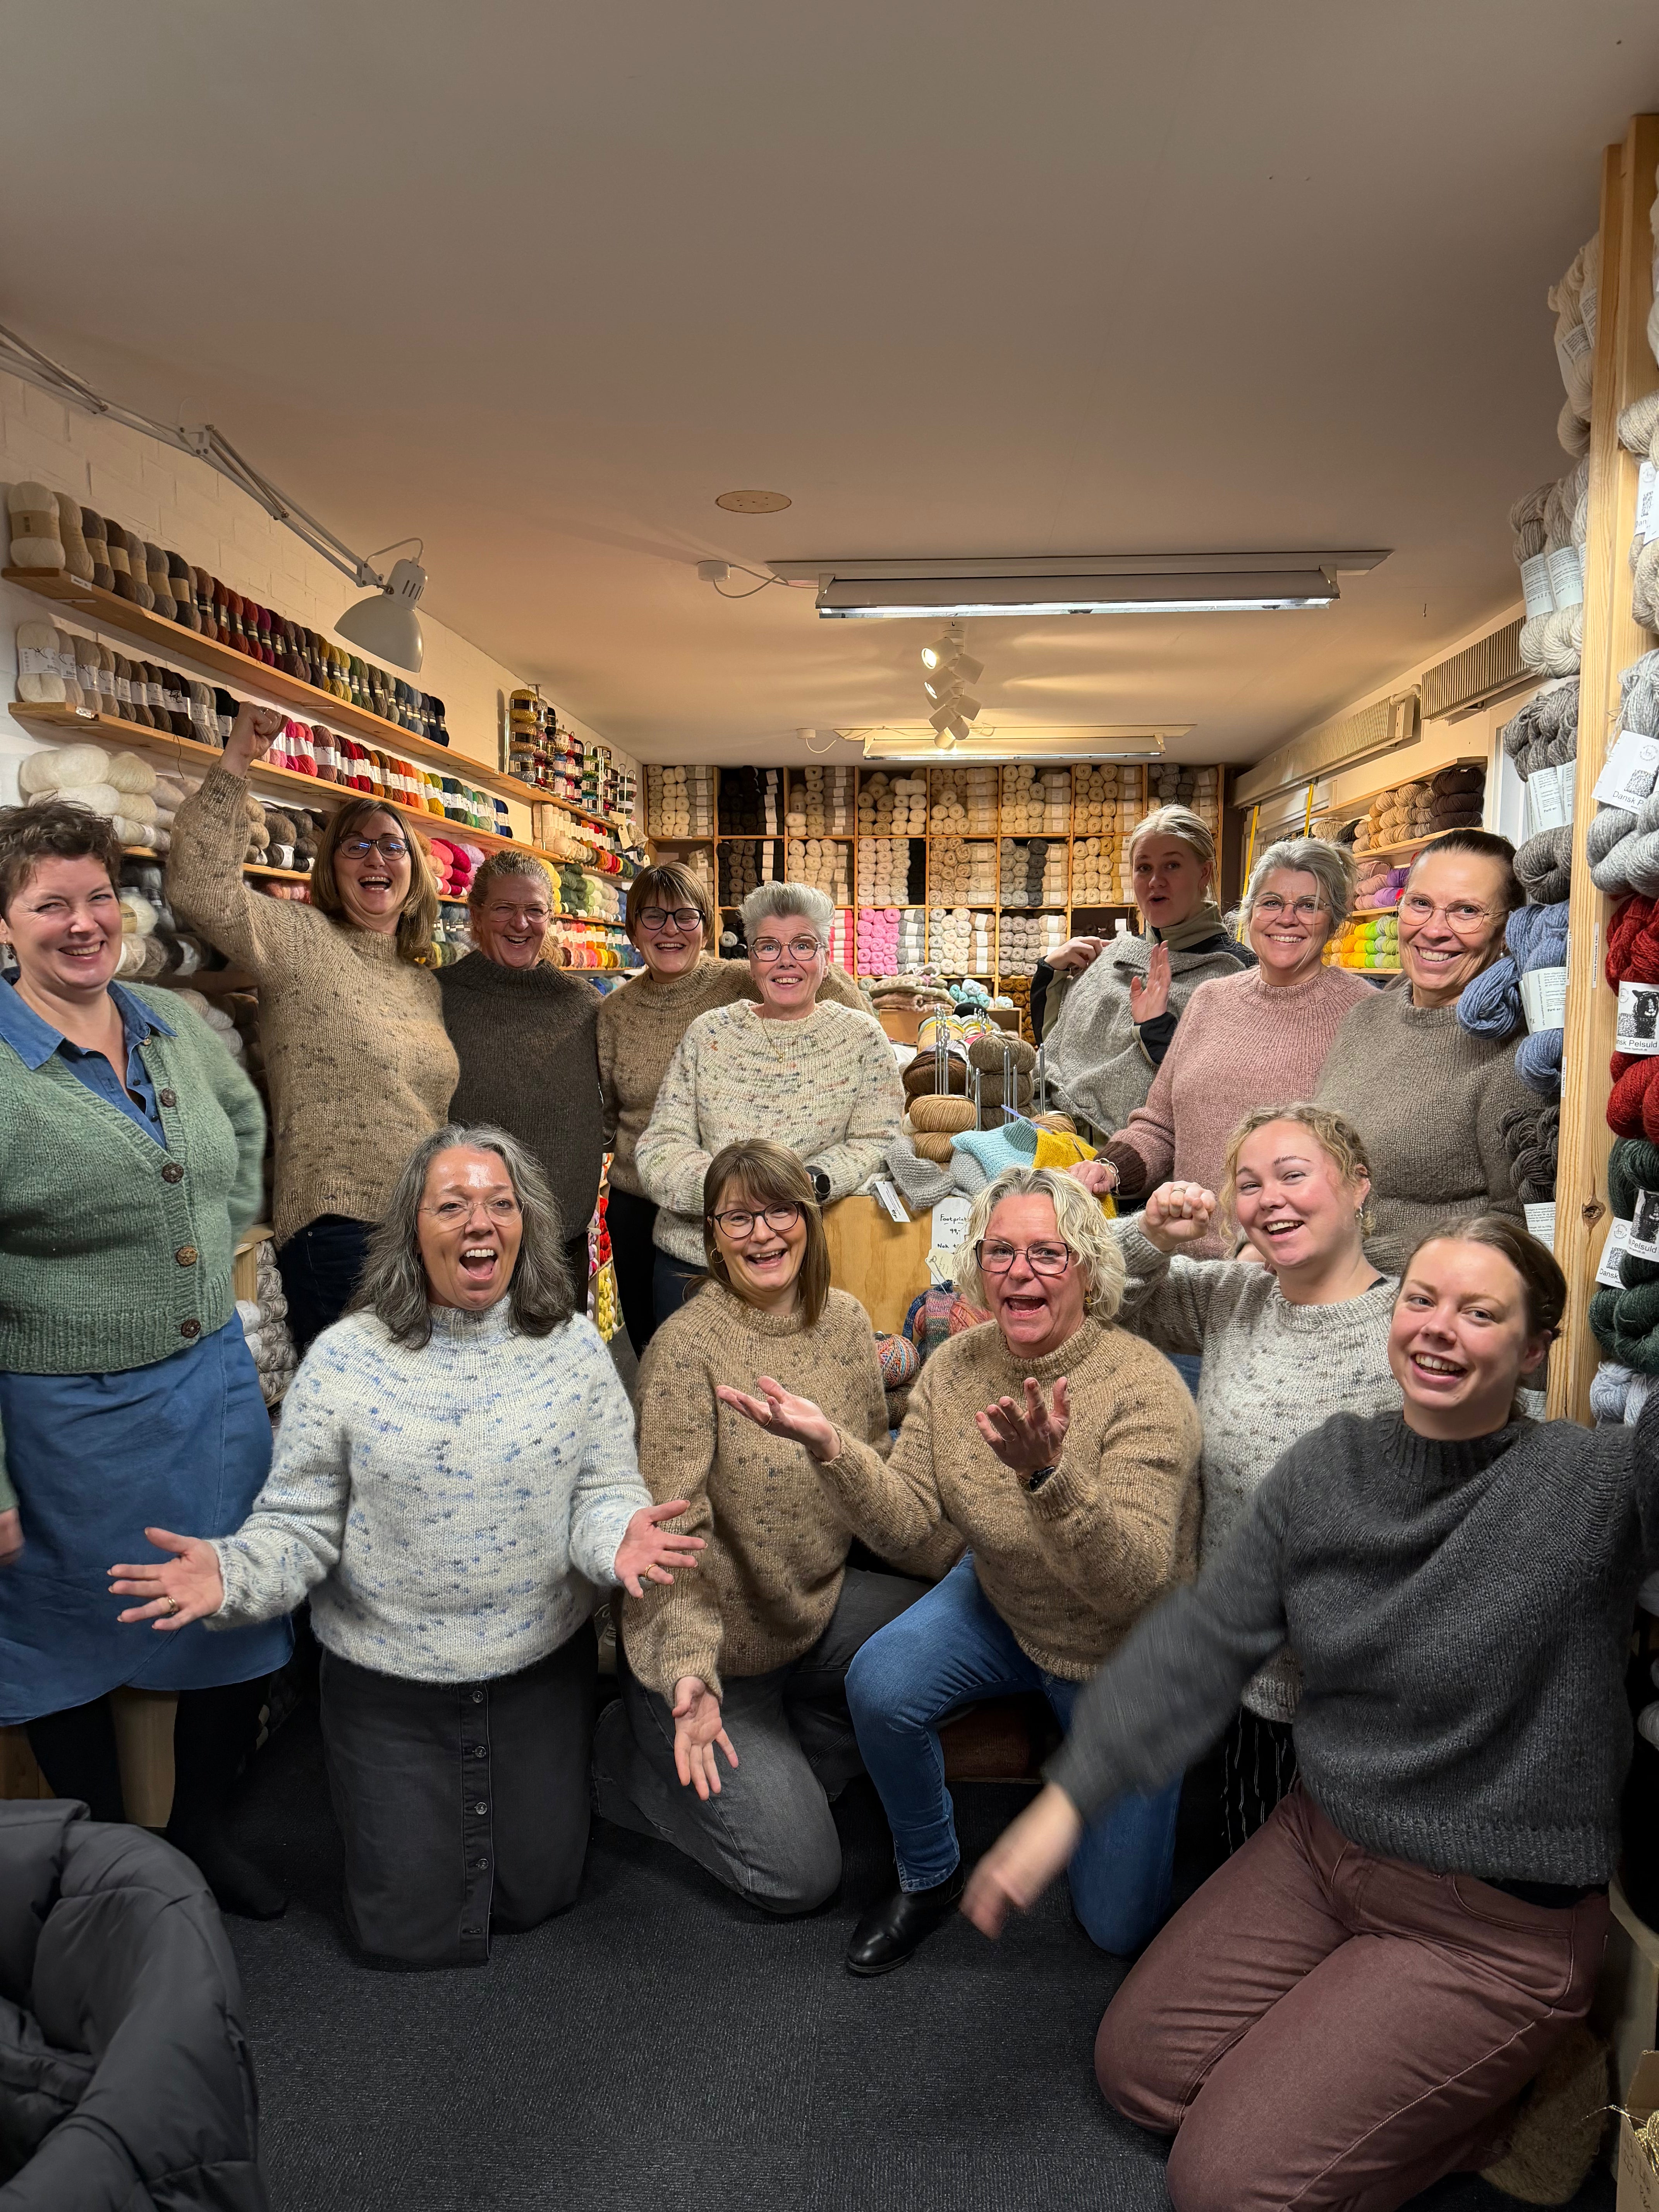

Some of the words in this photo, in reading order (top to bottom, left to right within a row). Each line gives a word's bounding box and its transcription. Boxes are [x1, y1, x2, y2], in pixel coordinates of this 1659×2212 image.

[1613, 791, 1636, 804] Dansk
[1629, 1040, 1657, 1048] Pelsuld
[1632, 1240, 1657, 1253] Pelsuld
[1599, 1268, 1619, 1279] Dansk
